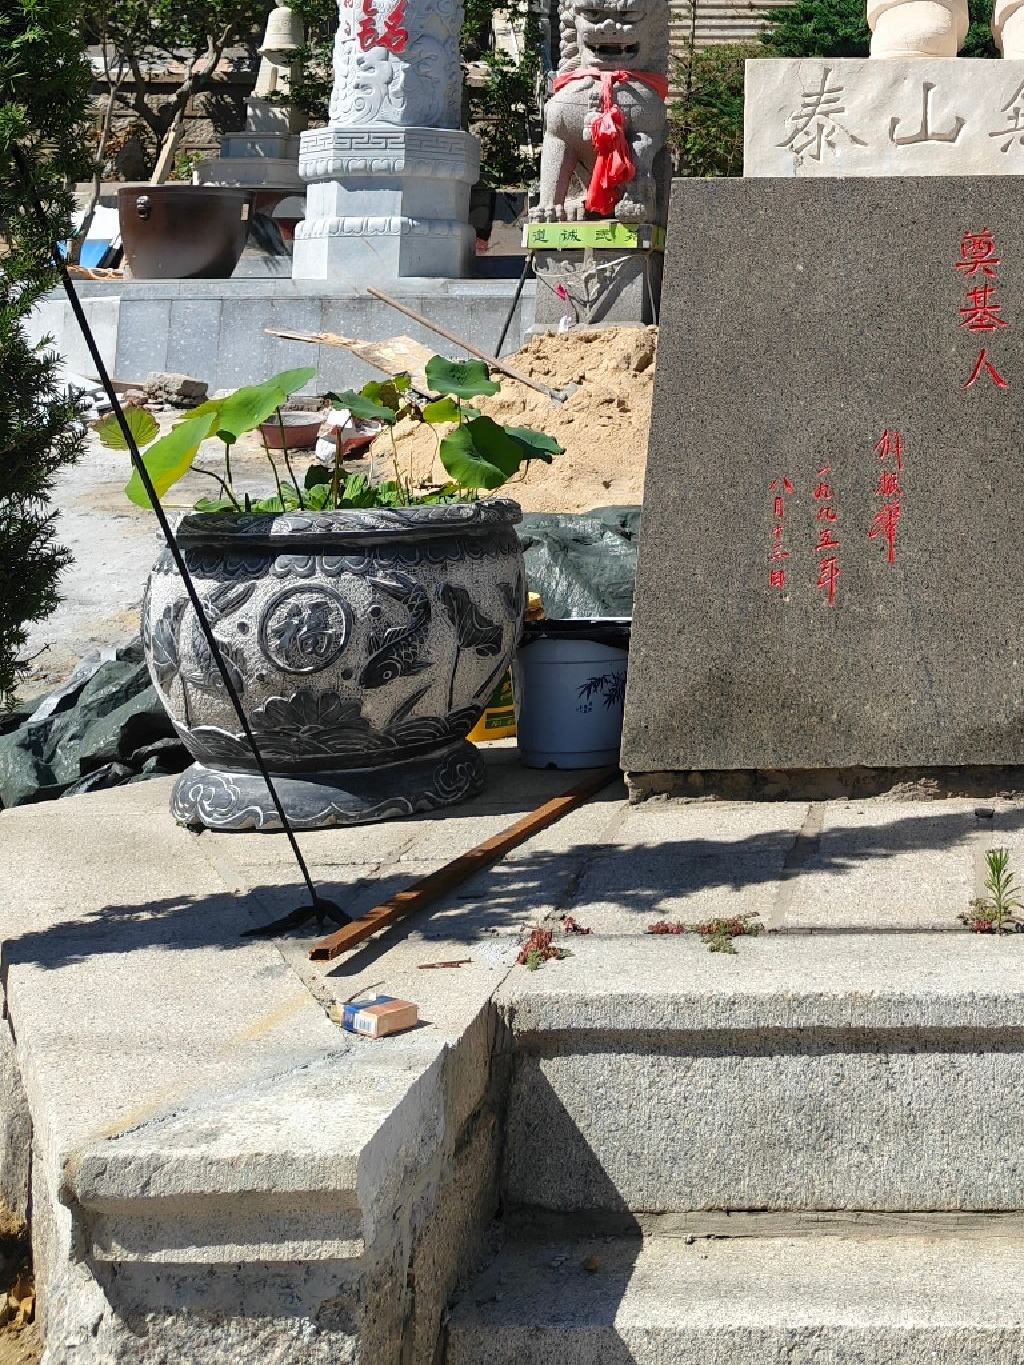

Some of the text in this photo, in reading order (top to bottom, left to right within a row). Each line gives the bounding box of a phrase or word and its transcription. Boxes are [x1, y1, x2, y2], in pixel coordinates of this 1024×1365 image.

[953, 227, 1009, 390] 奠基人
[812, 465, 842, 606] 一九九五年
